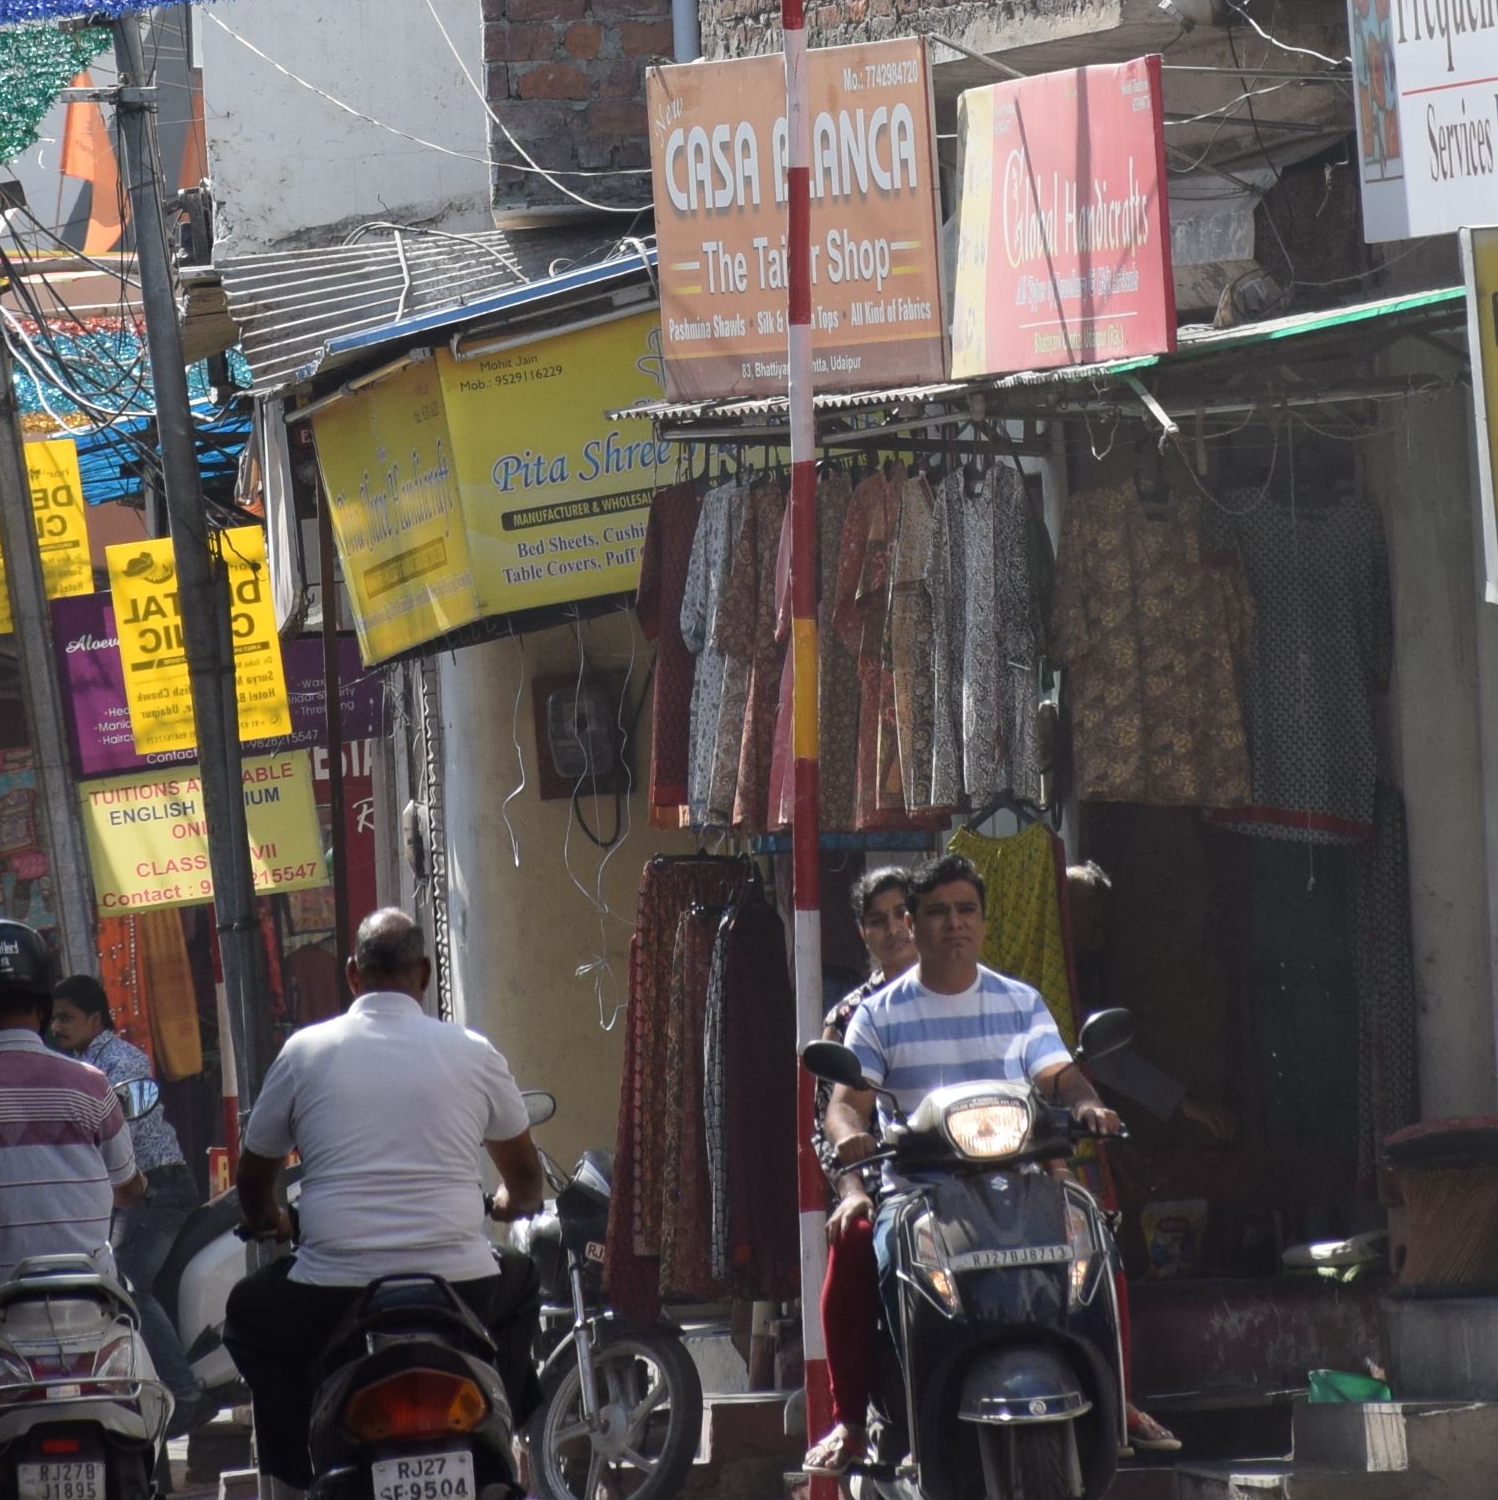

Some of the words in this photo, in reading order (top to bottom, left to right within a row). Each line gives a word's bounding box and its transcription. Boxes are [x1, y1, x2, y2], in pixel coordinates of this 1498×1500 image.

[865, 60, 918, 88] 7742984720
[655, 97, 683, 148] New
[1426, 96, 1493, 184] Services
[665, 121, 760, 211] CASA
[772, 103, 917, 202] BANCA
[1003, 148, 1058, 268] Global
[1065, 156, 1149, 258] Handicrafts
[702, 240, 748, 294] The
[753, 236, 820, 290] Tair
[826, 229, 889, 292] Shop
[669, 317, 712, 341] Pashmina
[713, 314, 745, 339] Shawls
[757, 310, 774, 334] Silk
[776, 313, 784, 332] &
[817, 306, 839, 334] Tops
[851, 302, 863, 325] All
[865, 300, 884, 325] Kind
[887, 298, 896, 322] of
[898, 297, 931, 321] Fabrics
[479, 356, 513, 372] Mohit
[515, 353, 538, 367] Jain
[495, 365, 563, 386] 9529116229
[755, 359, 790, 378] Bhattiya
[830, 355, 861, 374] Udaipur
[492, 449, 569, 493] Pita
[578, 431, 671, 481] Shree
[512, 502, 590, 527] MANUFACTURER
[592, 502, 600, 513] &
[517, 539, 545, 558] Bed
[550, 532, 599, 552] Sheets,
[502, 565, 543, 585] Table
[547, 557, 601, 578] Covers,
[605, 547, 636, 567] Puff
[146, 747, 198, 765] Contact
[89, 780, 180, 806] TUITIONS
[109, 800, 196, 826] ENGLISH
[172, 822, 209, 839] ONL
[136, 855, 207, 878] CLASS
[102, 884, 181, 909] Contact
[39, 1463, 95, 1481] RJ27B
[397, 1458, 446, 1479] RJ27
[42, 1481, 96, 1499] J1895
